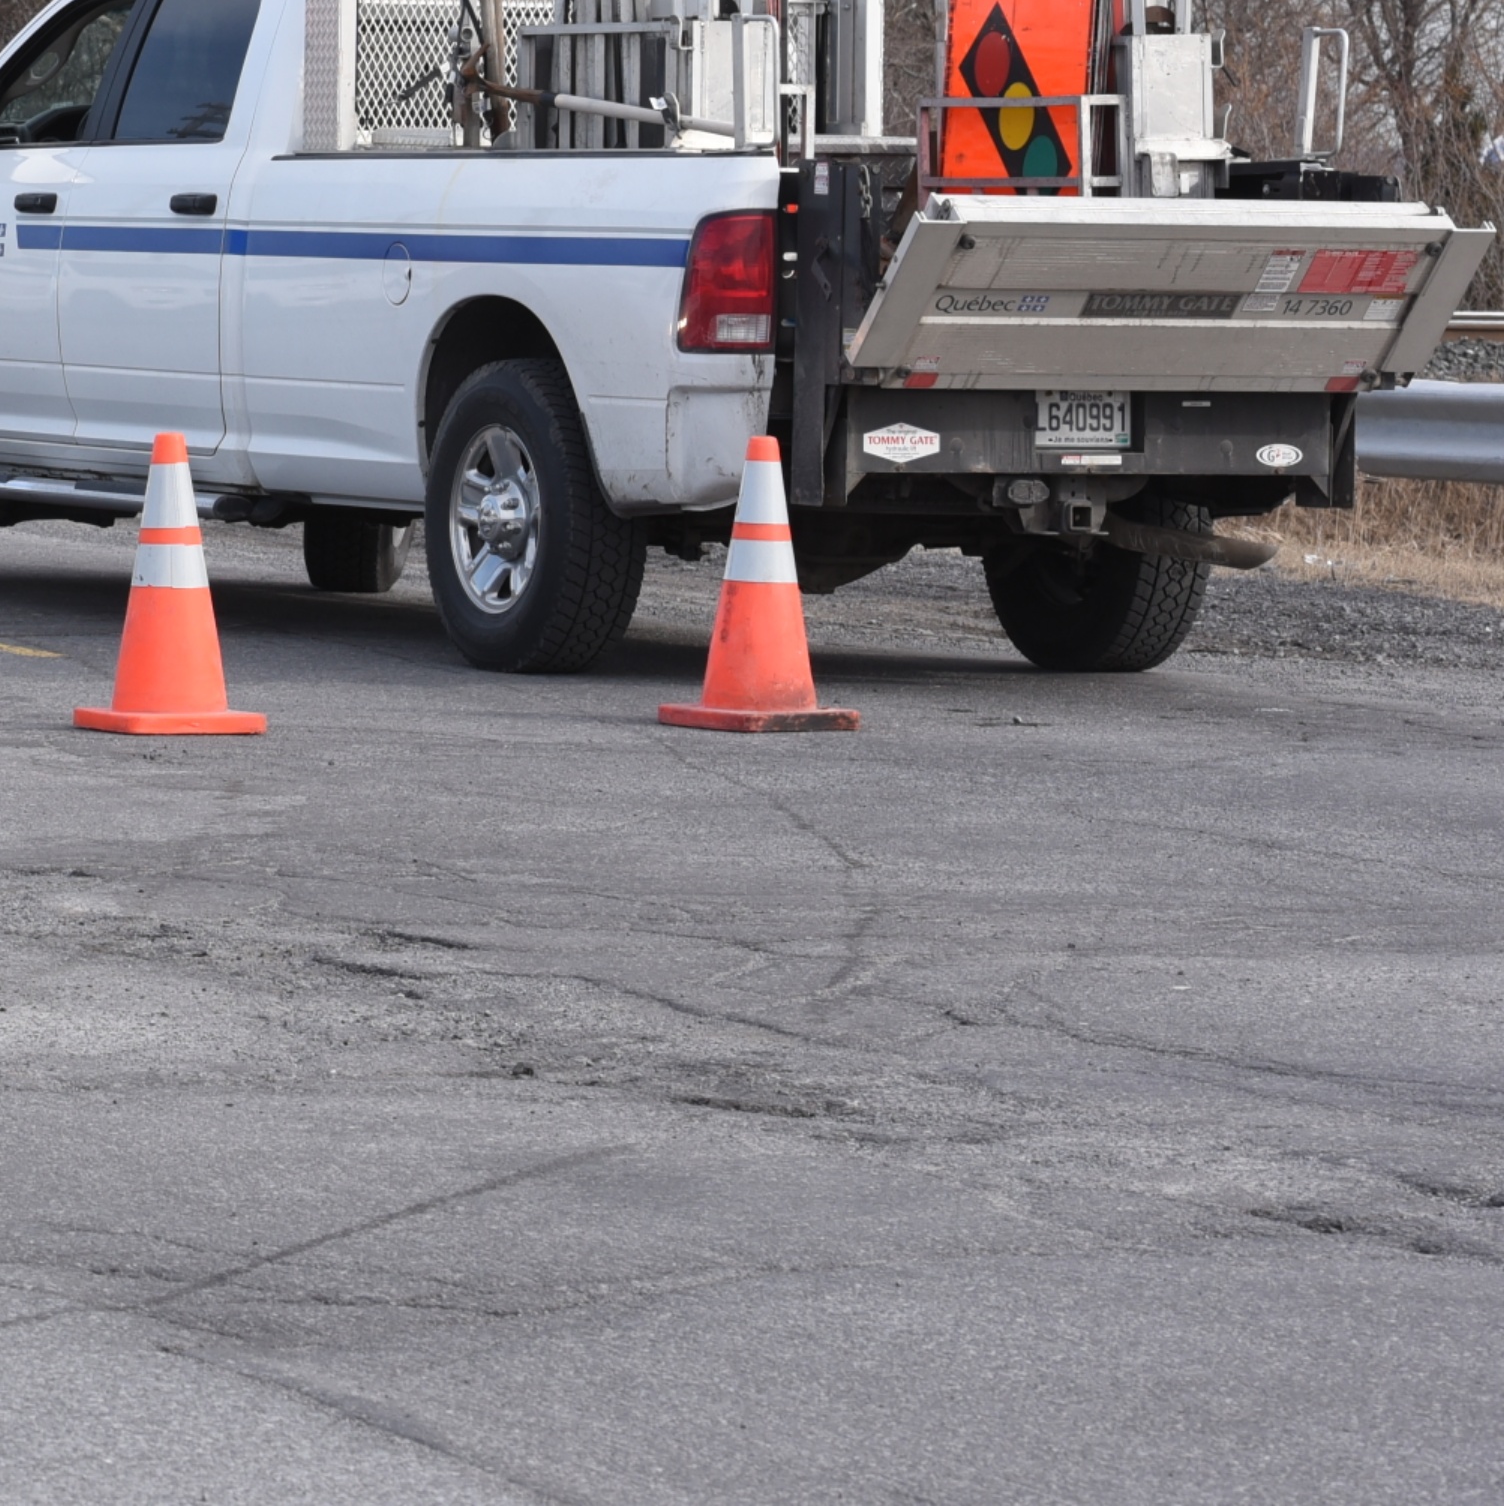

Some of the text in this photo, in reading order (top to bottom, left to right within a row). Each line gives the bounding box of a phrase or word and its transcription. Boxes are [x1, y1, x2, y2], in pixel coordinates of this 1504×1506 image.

[934, 294, 1018, 313] Québec
[1092, 294, 1173, 312] TOMMY
[1178, 295, 1235, 312] GATE
[1282, 299, 1301, 316] 14
[1305, 299, 1353, 316] 7360
[1068, 390, 1104, 402] Québec
[1035, 402, 1126, 432] L640991
[868, 436, 906, 445] TOMMY
